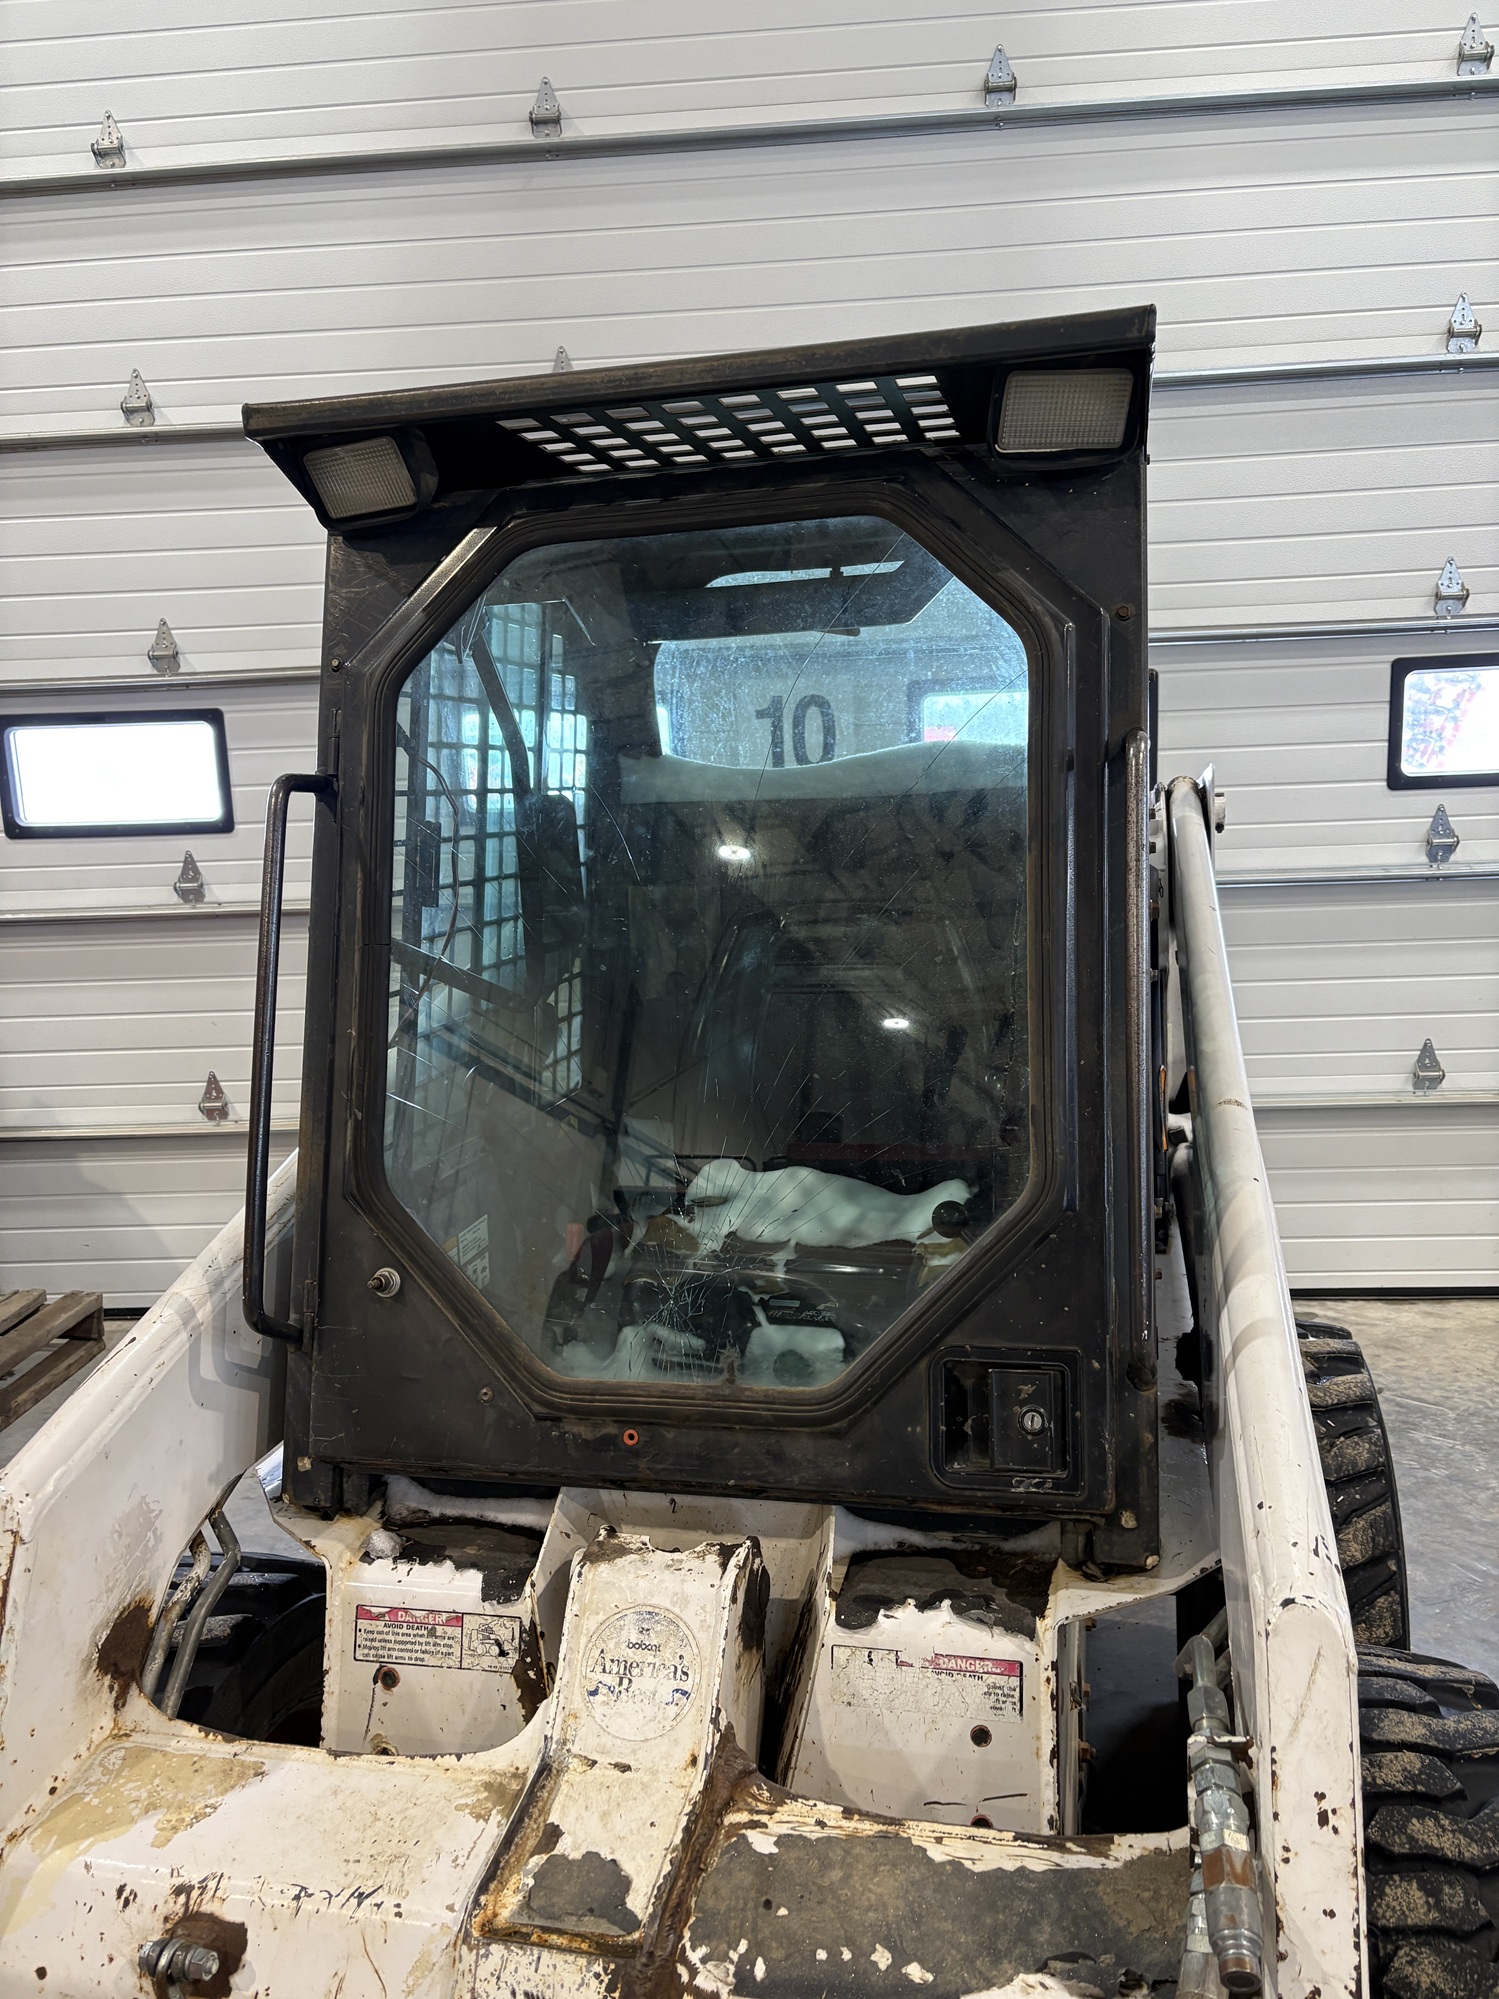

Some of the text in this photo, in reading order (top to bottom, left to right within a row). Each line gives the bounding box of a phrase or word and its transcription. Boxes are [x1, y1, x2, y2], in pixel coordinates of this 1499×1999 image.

[755, 694, 836, 768] 10
[397, 1610, 445, 1625] DANGER
[363, 1628, 375, 1636] Keep
[383, 1622, 429, 1632] AVOID DEATH
